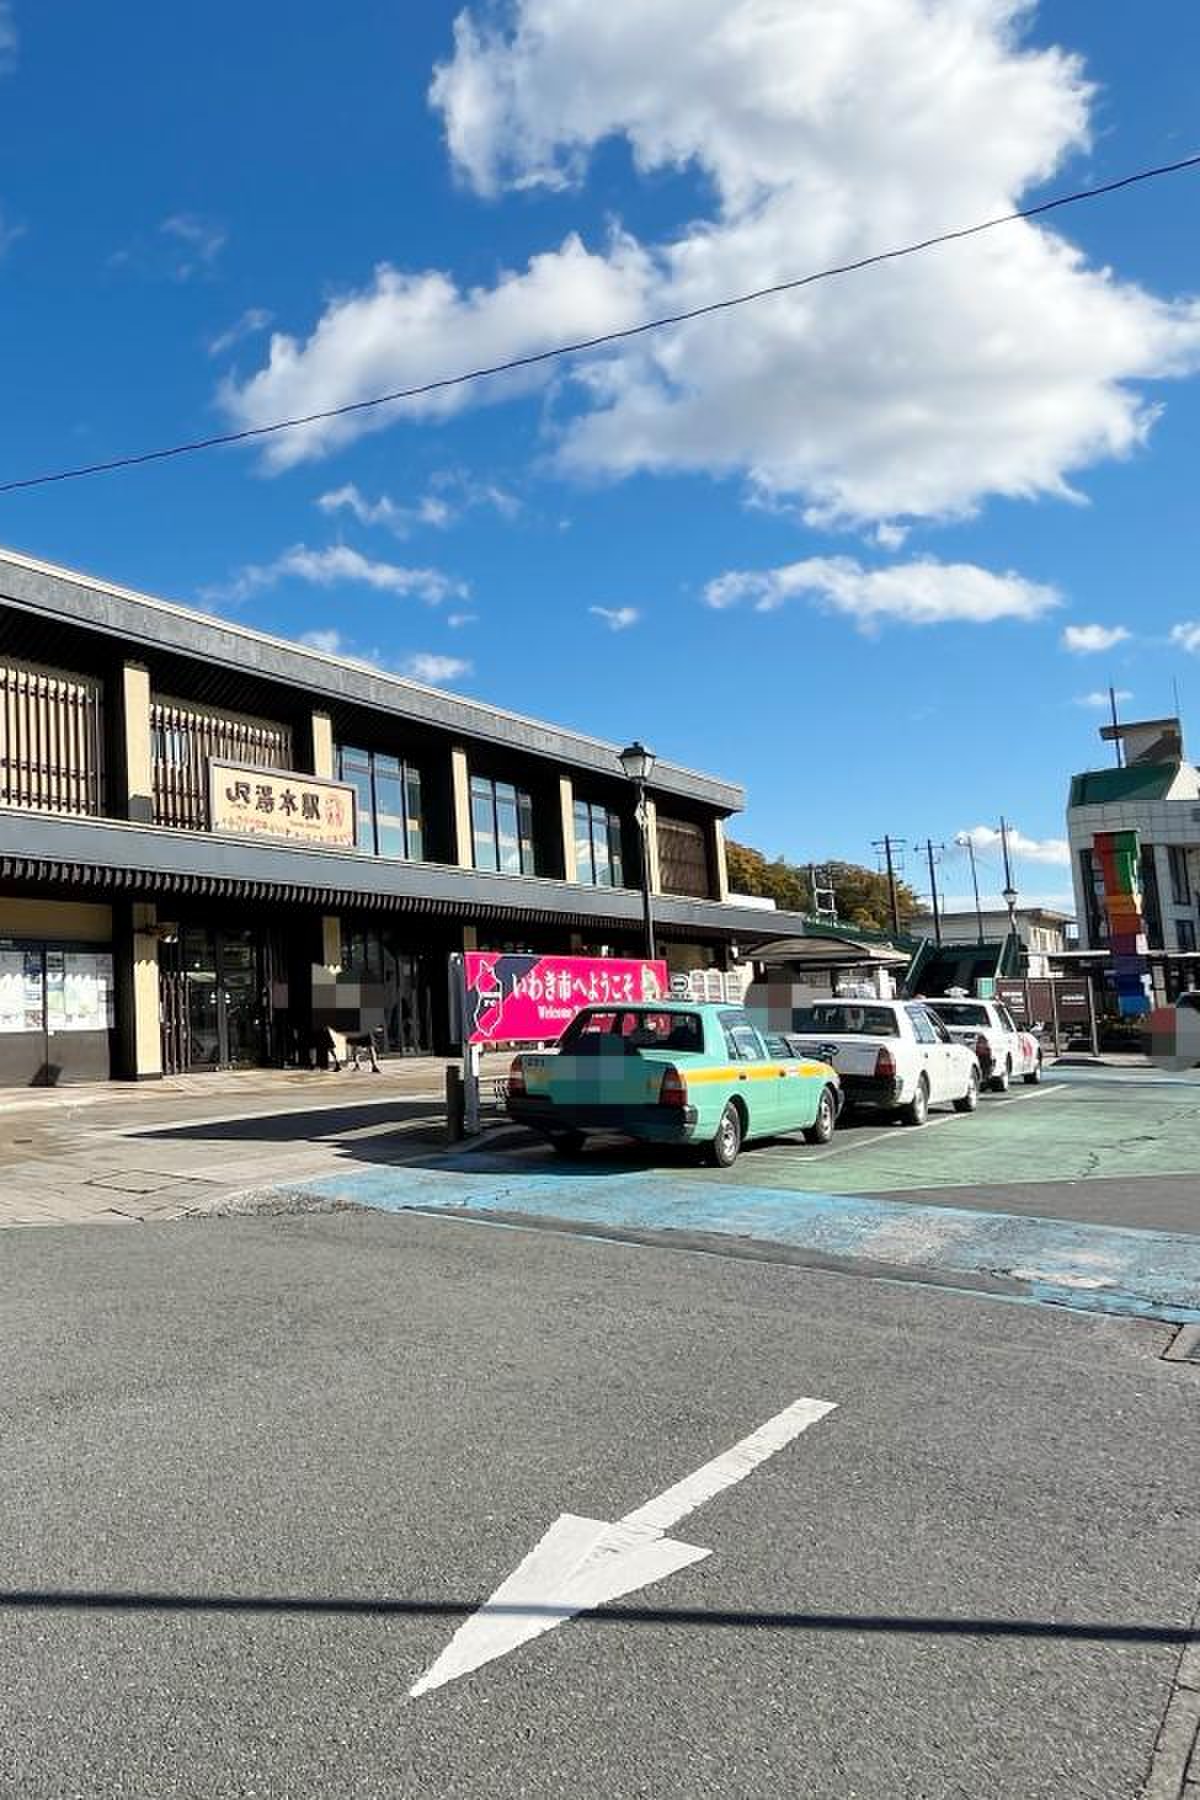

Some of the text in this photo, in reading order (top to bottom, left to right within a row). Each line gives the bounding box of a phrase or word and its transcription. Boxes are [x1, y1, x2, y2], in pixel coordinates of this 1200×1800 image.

[511, 969, 634, 1002] いわき市へようこそ
